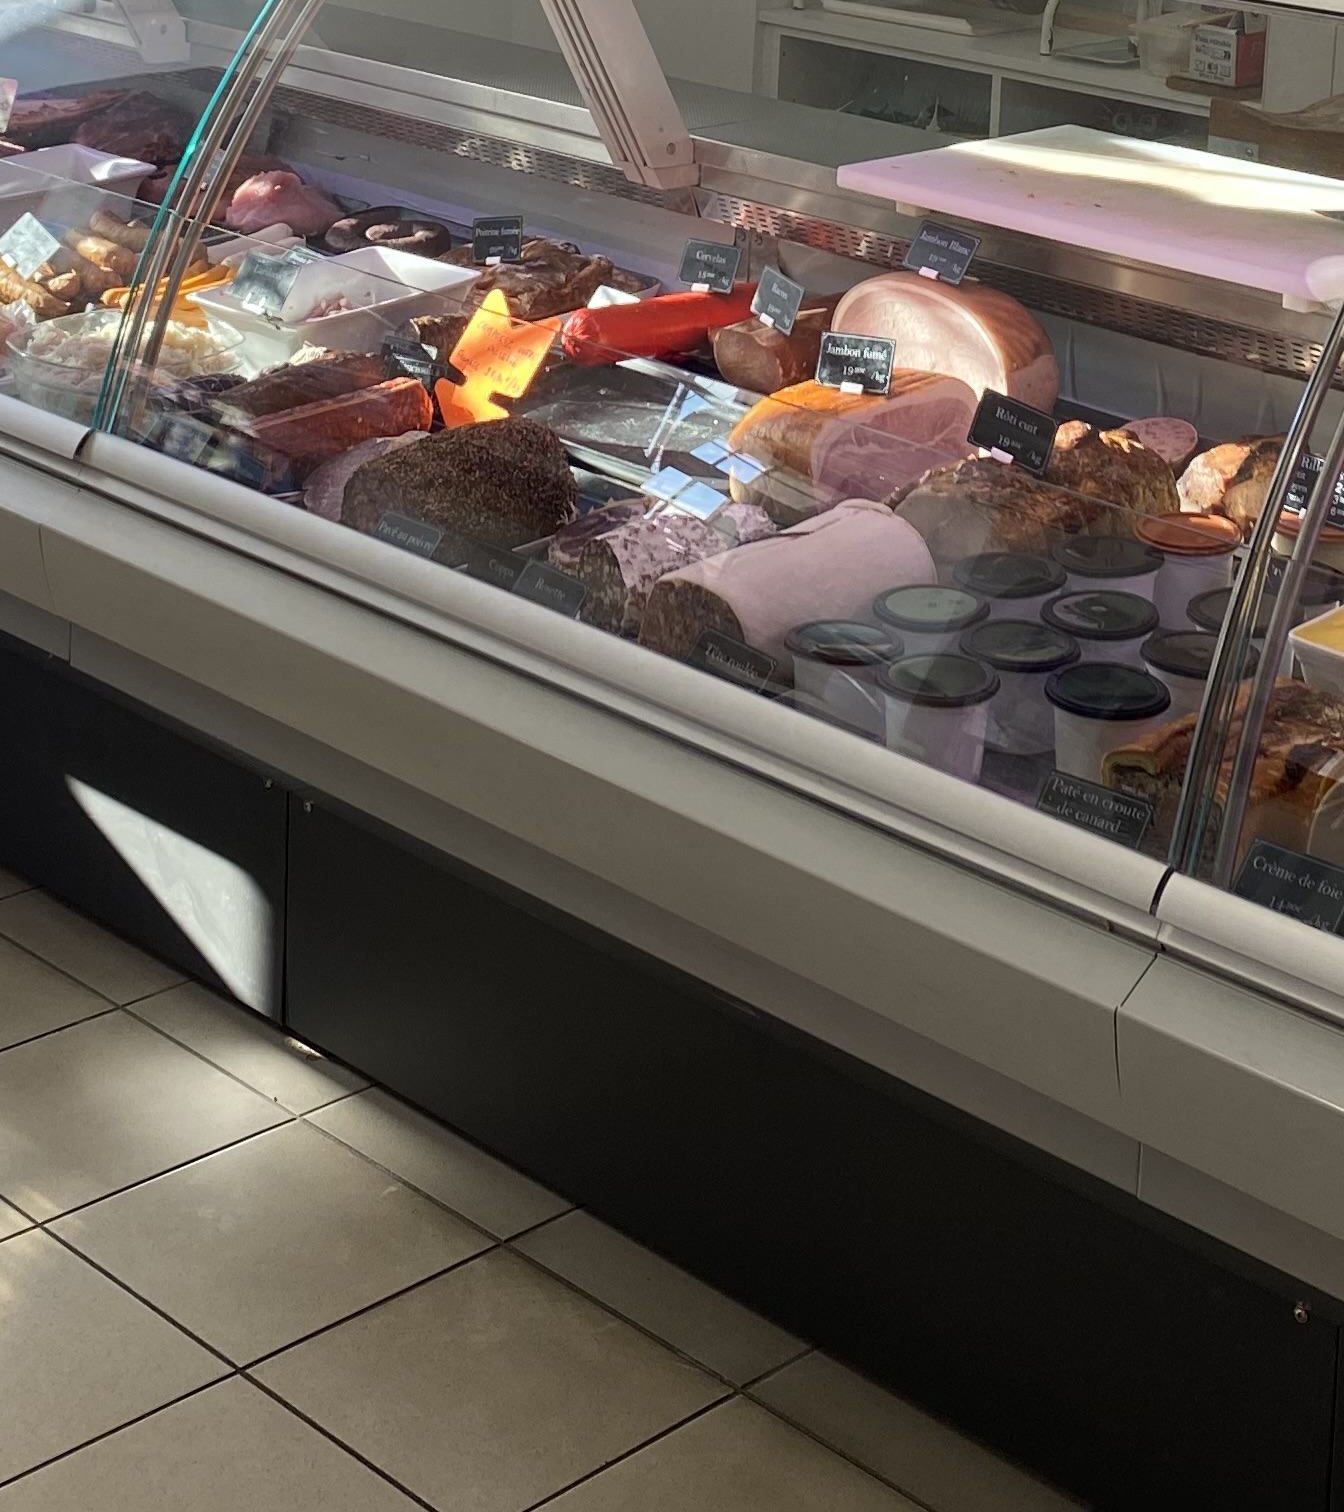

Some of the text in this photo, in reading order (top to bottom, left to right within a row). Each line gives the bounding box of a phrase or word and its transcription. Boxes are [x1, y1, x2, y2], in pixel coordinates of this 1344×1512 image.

[826, 342, 888, 360] Jambon fumé
[1018, 419, 1038, 435] cuit
[378, 520, 397, 538] Pavé
[406, 534, 435, 552] poivre
[1053, 777, 1145, 821] Paté en croute
[1056, 800, 1122, 834] de canard
[1253, 855, 1344, 901] Crème de foie
